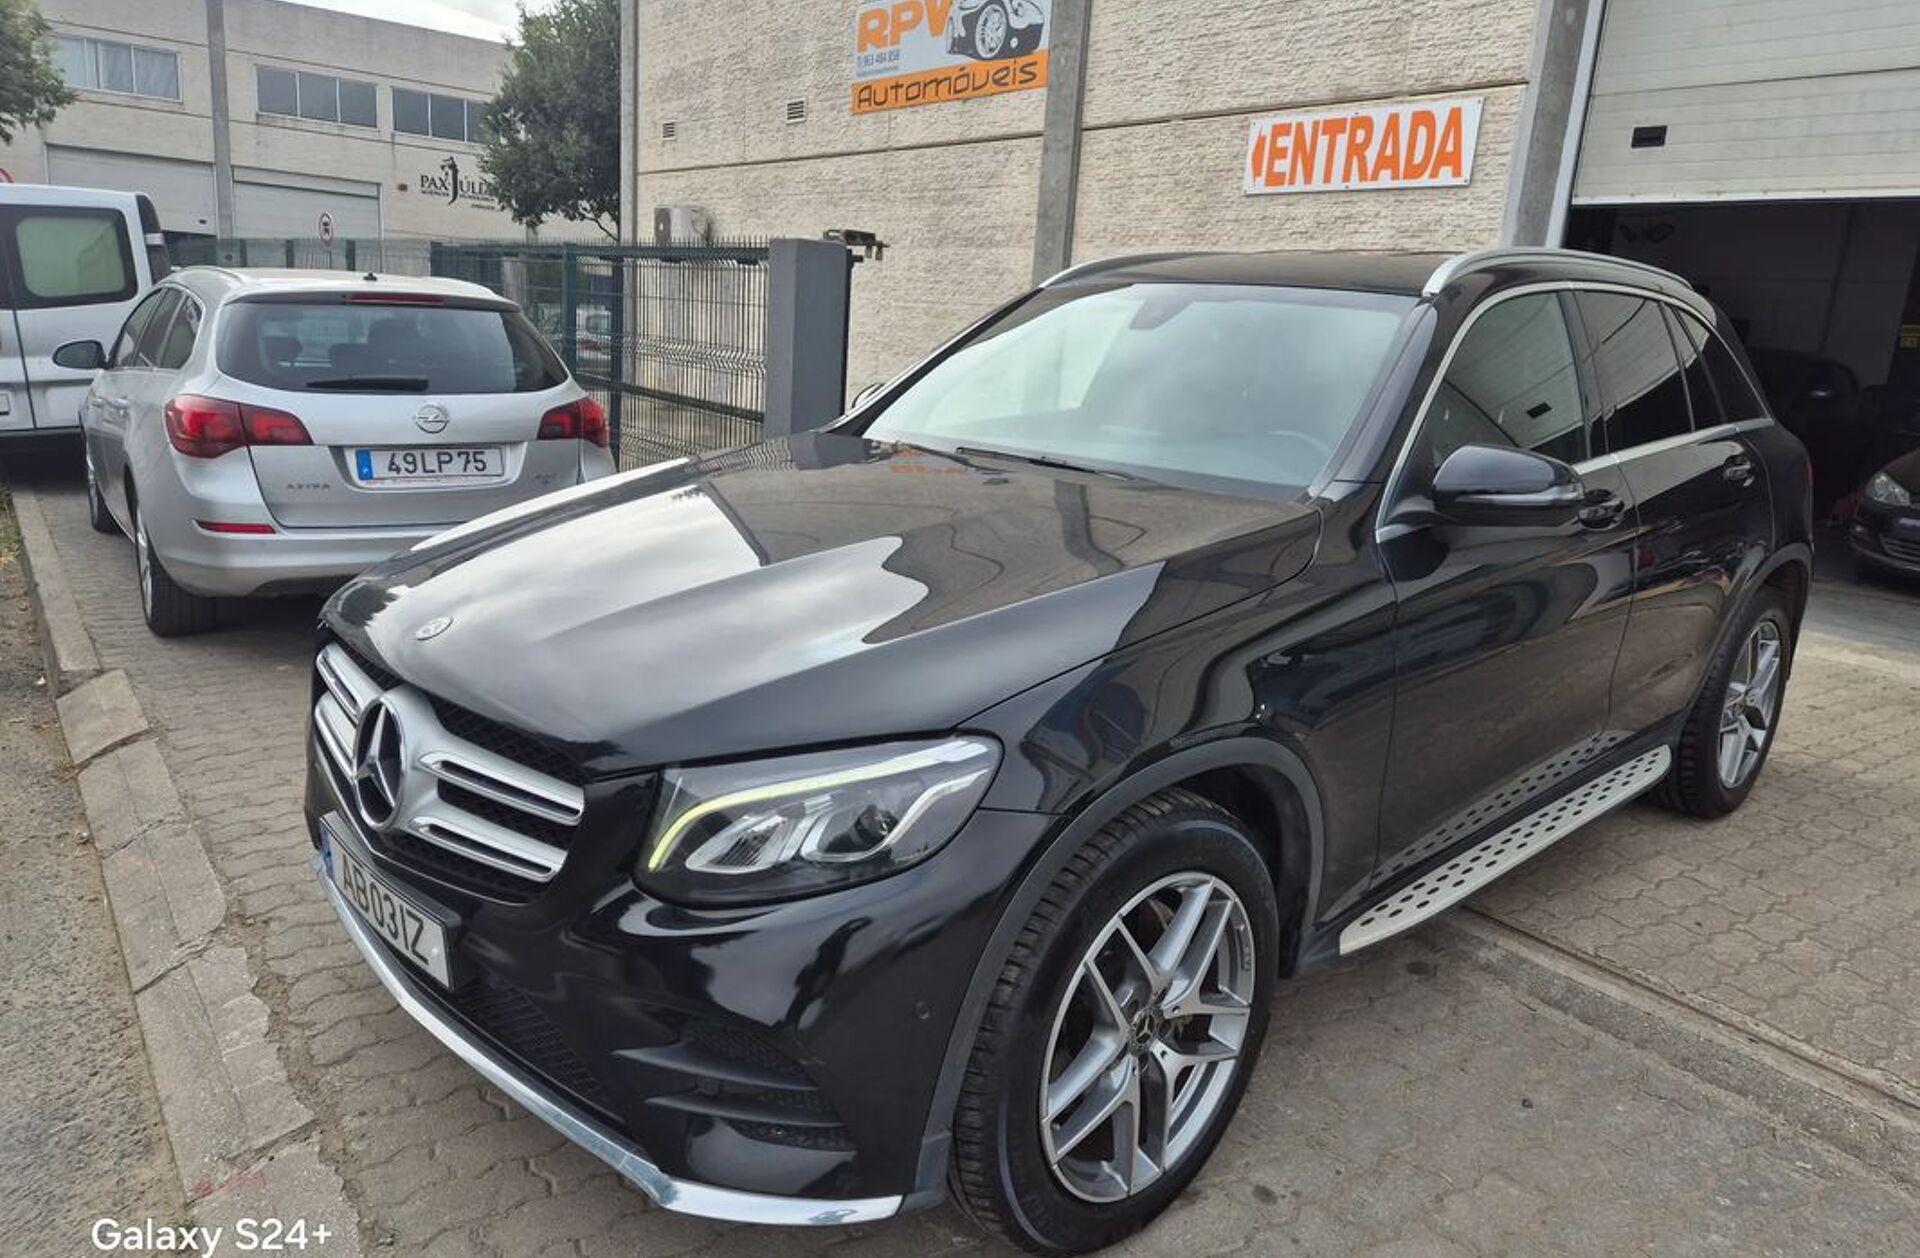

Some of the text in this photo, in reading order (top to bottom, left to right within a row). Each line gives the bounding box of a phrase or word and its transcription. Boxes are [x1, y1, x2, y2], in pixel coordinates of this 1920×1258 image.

[857, 0, 952, 53] RPV
[857, 60, 1038, 109] Automóveis
[1264, 106, 1462, 187] ENTRADA
[420, 174, 449, 191] PAX
[387, 450, 487, 475] 49LP75
[342, 852, 430, 967] AB03IZ
